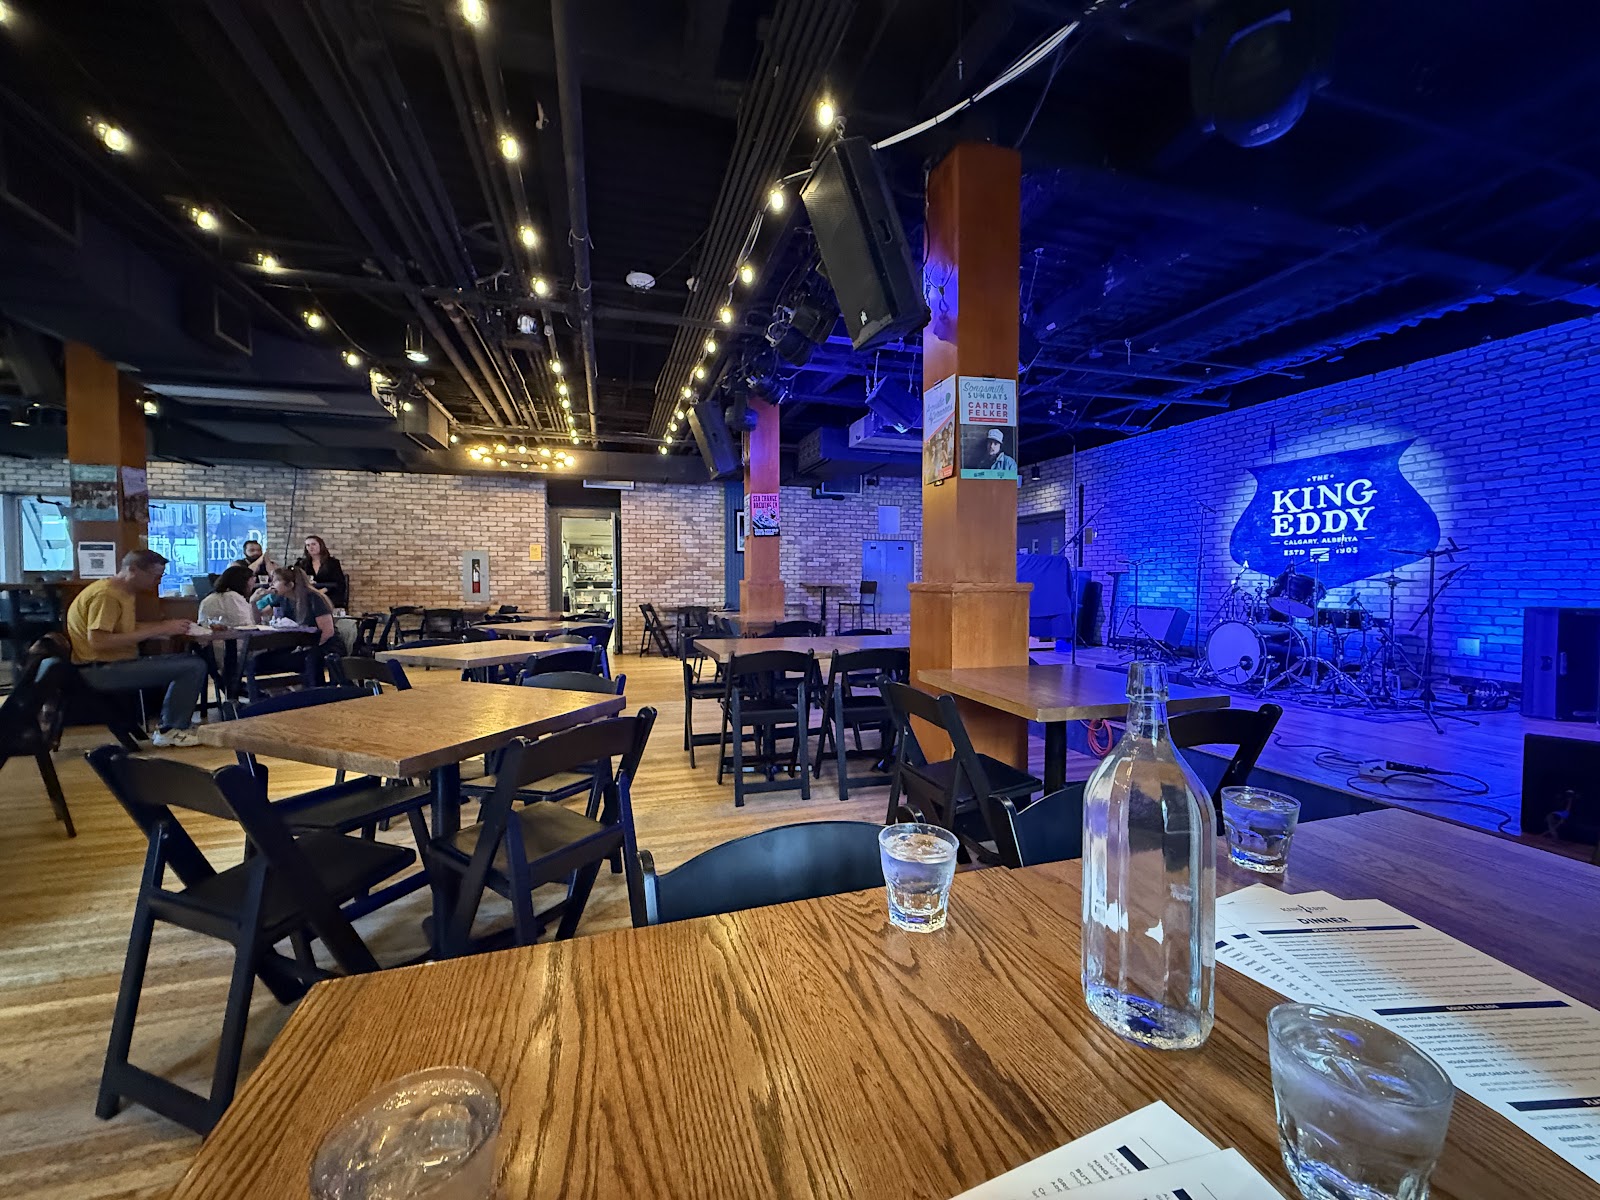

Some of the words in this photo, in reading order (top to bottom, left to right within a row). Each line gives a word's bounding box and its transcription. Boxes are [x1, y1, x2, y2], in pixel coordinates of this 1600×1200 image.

[963, 382, 1005, 393] Songsmith
[968, 392, 1008, 400] SUNDAYS
[968, 402, 1008, 410] CARTER
[968, 409, 1008, 417] FELKER
[1312, 474, 1329, 482] THE
[1271, 478, 1378, 514] KING
[1270, 506, 1376, 537] EDDY
[1321, 536, 1358, 544] ALBERTA
[1296, 917, 1352, 925] DINNER
[1093, 1160, 1109, 1175] KING
